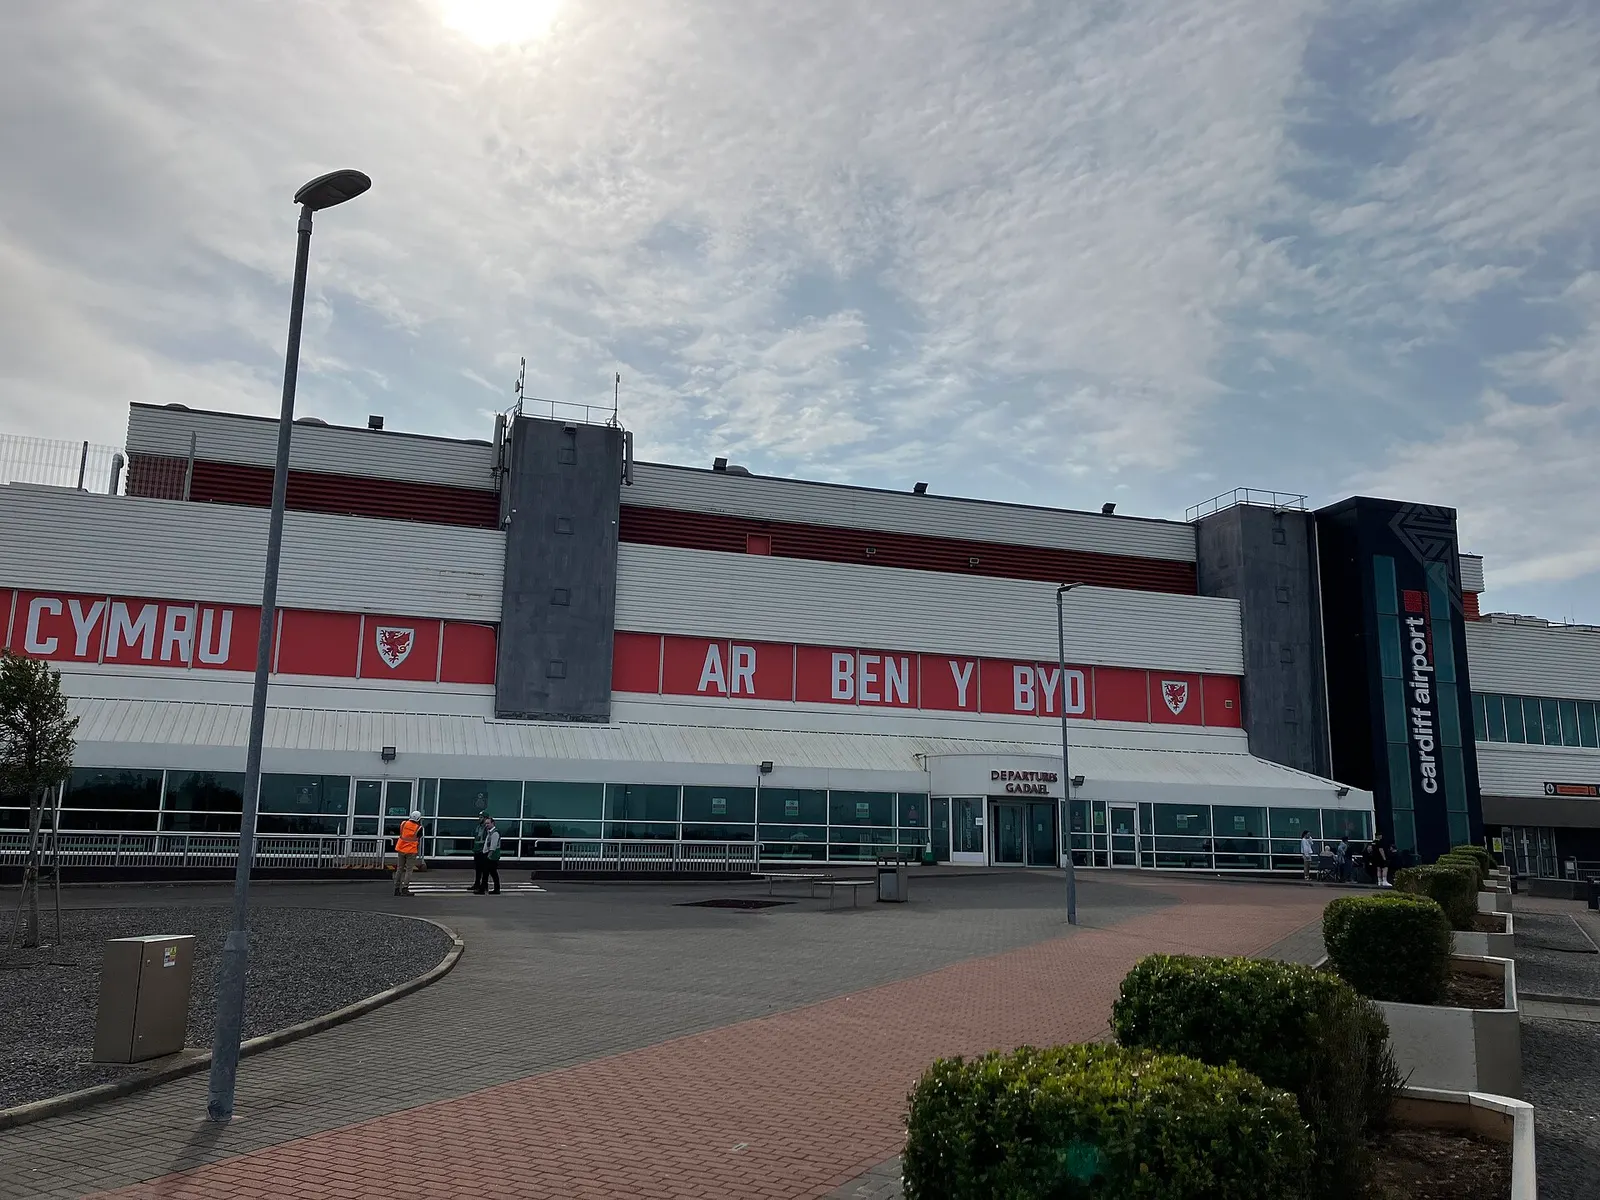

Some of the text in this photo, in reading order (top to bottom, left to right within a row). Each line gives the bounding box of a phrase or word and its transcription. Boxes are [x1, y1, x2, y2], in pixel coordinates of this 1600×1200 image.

[23, 598, 233, 664] CYMRU
[697, 643, 1086, 714] AR BEN Y BYD
[1406, 616, 1438, 794] cardiff airport
[991, 770, 1058, 783] DEPARTURES
[1005, 782, 1050, 795] GADAEL
